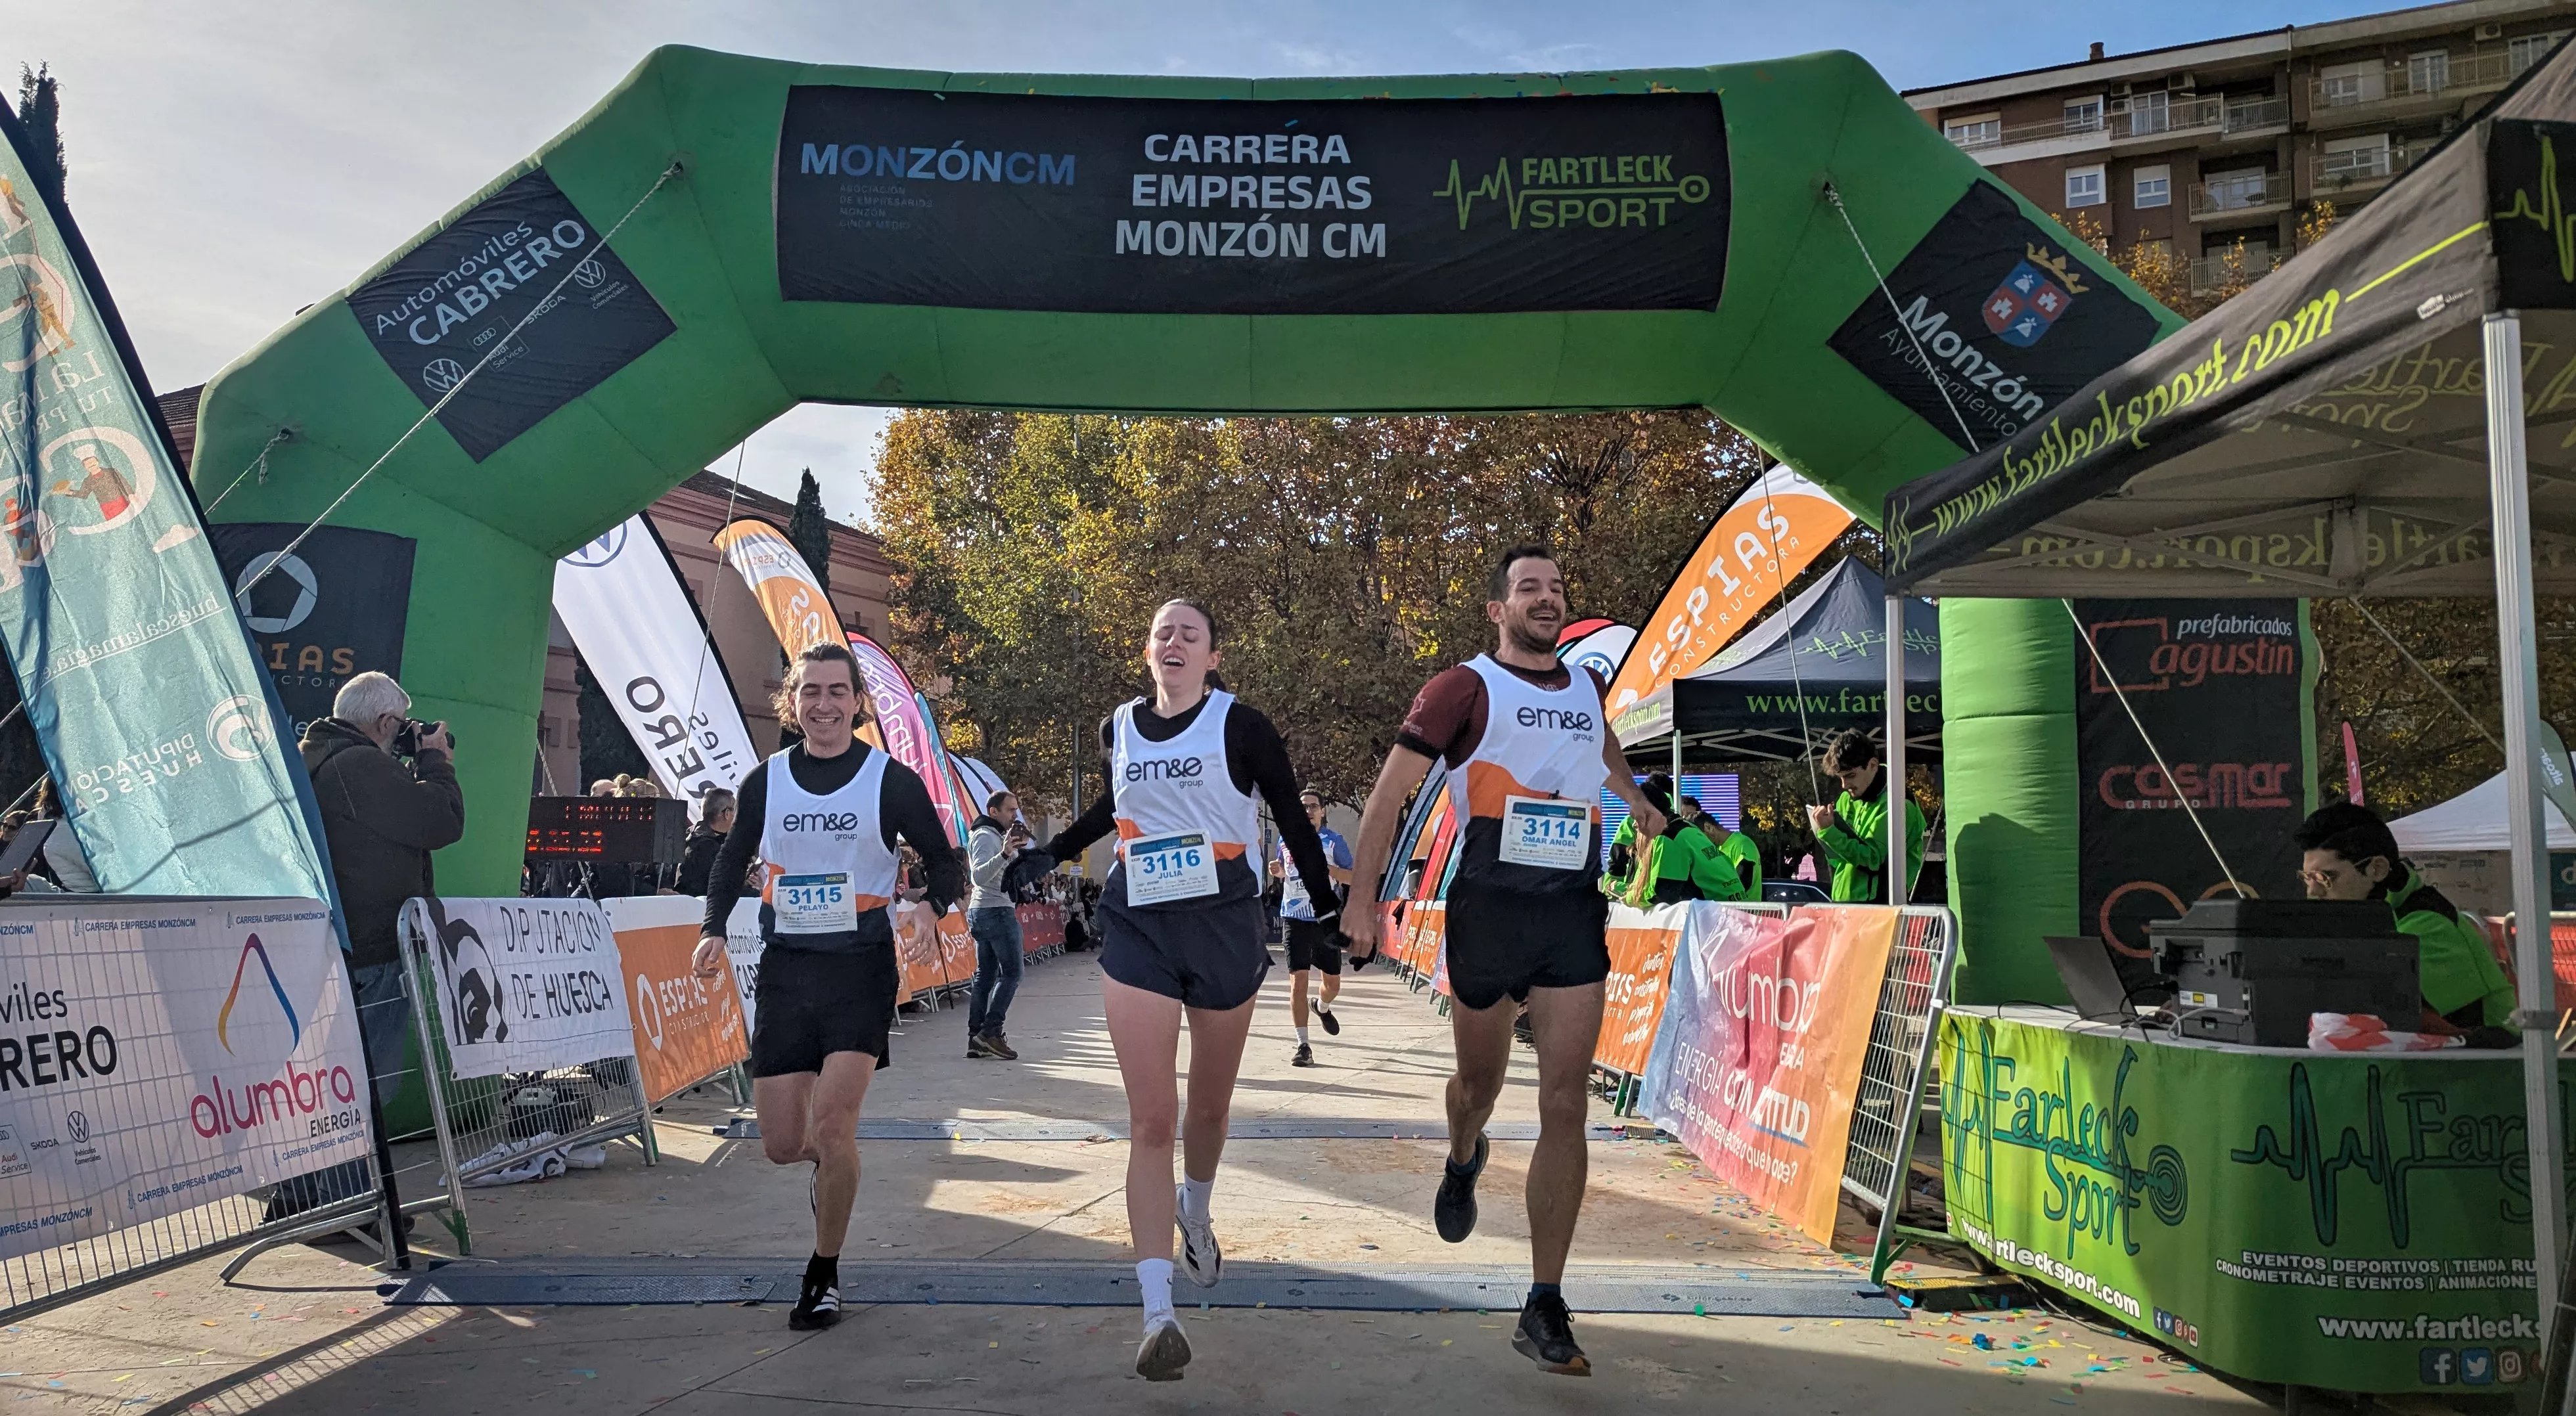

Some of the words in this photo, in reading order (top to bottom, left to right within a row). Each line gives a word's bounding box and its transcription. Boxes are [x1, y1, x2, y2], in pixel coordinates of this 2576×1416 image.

[1145, 133, 1351, 164] CARRERA
[800, 140, 1076, 186] MONZÓNCM
[1523, 154, 1674, 185] FARTLECK
[1132, 173, 1372, 210] EMPRESAS
[1529, 197, 1675, 229] SPORT
[1116, 213, 1309, 257] MONZÓN
[1322, 223, 1386, 258] CM
[376, 220, 533, 336] Automóviles
[407, 219, 586, 346] CABRERO
[492, 345, 525, 369] Service
[1902, 294, 2045, 421] Monzón
[1879, 327, 2018, 437] Ayuntamiento
[1648, 503, 1790, 677] ESPIAS
[1655, 535, 1800, 688] CONSTRUCTORA
[2176, 613, 2293, 640] prefabricados
[268, 642, 355, 675] IAS
[1516, 706, 1593, 731] em&e
[1572, 732, 1594, 743] group
[1125, 756, 1202, 782] em&e
[1179, 778, 1204, 789] group
[2125, 799, 2202, 810] GRUPO
[782, 812, 859, 832] em&e
[1522, 818, 1580, 840] 3114
[834, 833, 858, 841] group
[1522, 835, 1547, 845] OMAR
[1142, 849, 1200, 874] 3116
[1158, 870, 1183, 879] JULIA
[788, 886, 842, 905] 3115
[85, 921, 119, 932] CARRERA
[121, 920, 156, 930] EMPRESAS
[158, 917, 196, 928] MONZÓNCM
[511, 973, 540, 1019] DE
[542, 970, 614, 1017] HUESCA
[1675, 1040, 1723, 1098] ENERGÍA
[190, 1060, 356, 1139] alumbra
[1686, 1098, 1696, 1121] de
[1696, 1103, 1705, 1126] la
[309, 1105, 361, 1138] ENERGÍA
[1, 1152, 18, 1163] Audi
[282, 1147, 309, 1161] CARRERA
[311, 1139, 337, 1153] EMPRESAS
[1, 1162, 28, 1175] Service
[137, 1187, 171, 1203] CARRERA
[171, 1176, 207, 1193] EMPRESAS
[208, 1164, 244, 1184] MONZÓNCM
[2043, 1138, 2141, 1260] Sport
[41, 1206, 93, 1228] MONZÓNCM
[2215, 1258, 2339, 1288] CRONOMETRAJE
[2345, 1275, 2426, 1291] EVENTOS
[2438, 1275, 2538, 1291] ANIMACIONE
[2242, 1250, 2326, 1272] EVENTOS
[2332, 1258, 2440, 1274] DEPORTIVOS
[2452, 1259, 2507, 1273] TIENDA
